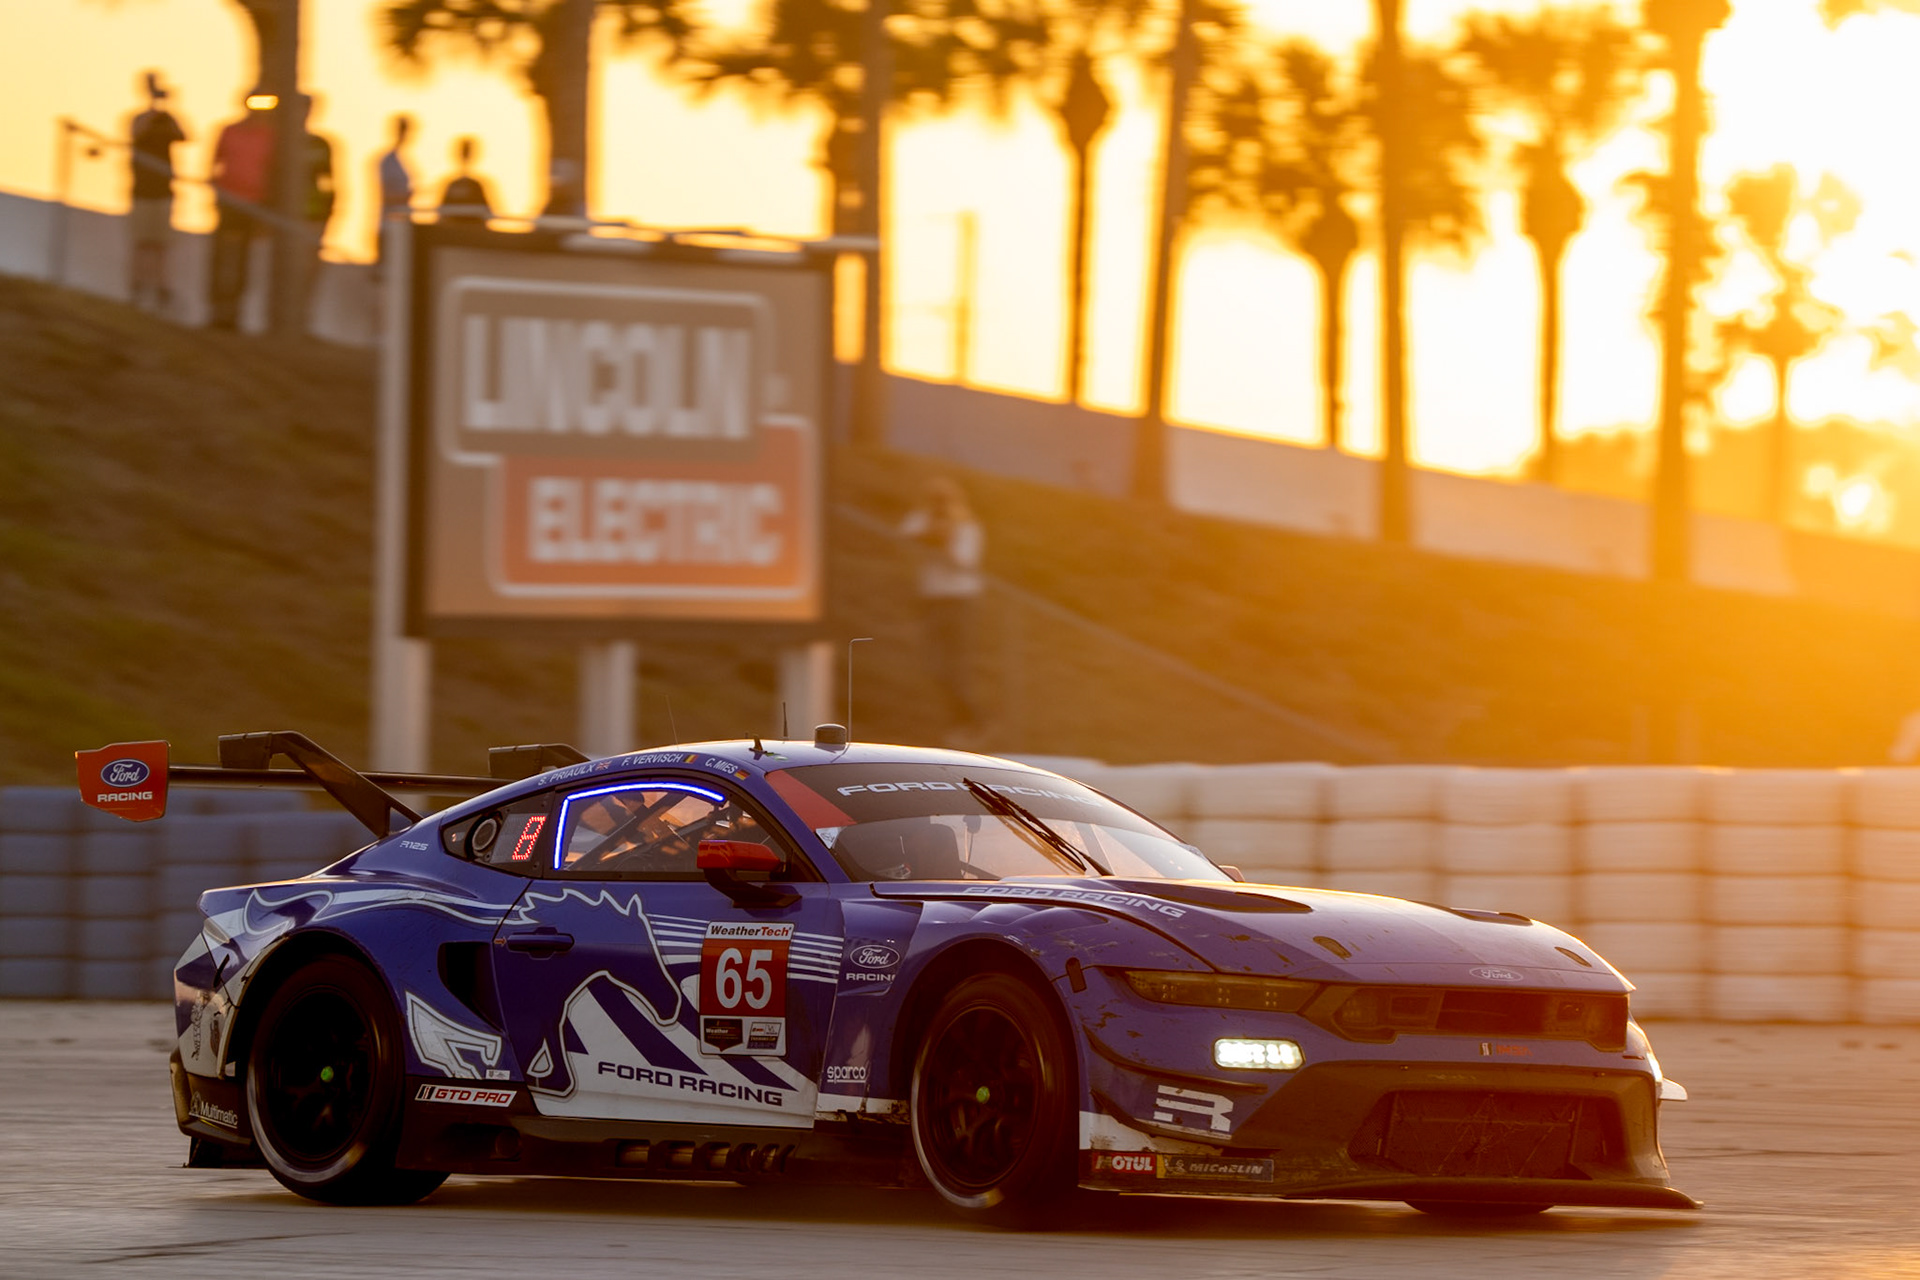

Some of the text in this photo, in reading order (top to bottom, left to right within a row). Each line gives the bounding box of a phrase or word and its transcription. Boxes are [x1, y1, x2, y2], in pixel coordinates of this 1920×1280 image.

[464, 315, 752, 439] LINCOLN
[528, 477, 781, 565] ELECTRIC
[621, 753, 683, 767] F. VERVISCH
[704, 757, 739, 774] C. MIES
[110, 763, 141, 782] Ford
[538, 764, 595, 786] S. PRIAULX
[97, 791, 153, 803] RACING
[837, 781, 957, 796] FORD
[963, 886, 1187, 918] FORD RACING
[710, 925, 789, 937] WeatherTech
[859, 947, 891, 965] Ford
[715, 947, 772, 1010] 65
[1481, 968, 1514, 979] Ford
[827, 1065, 867, 1083] sparco
[598, 1061, 782, 1107] FORD RACING
[435, 1088, 511, 1104] GTD PRO
[200, 1100, 238, 1126] Multimatic
[1189, 1163, 1264, 1175] MICHELIN
